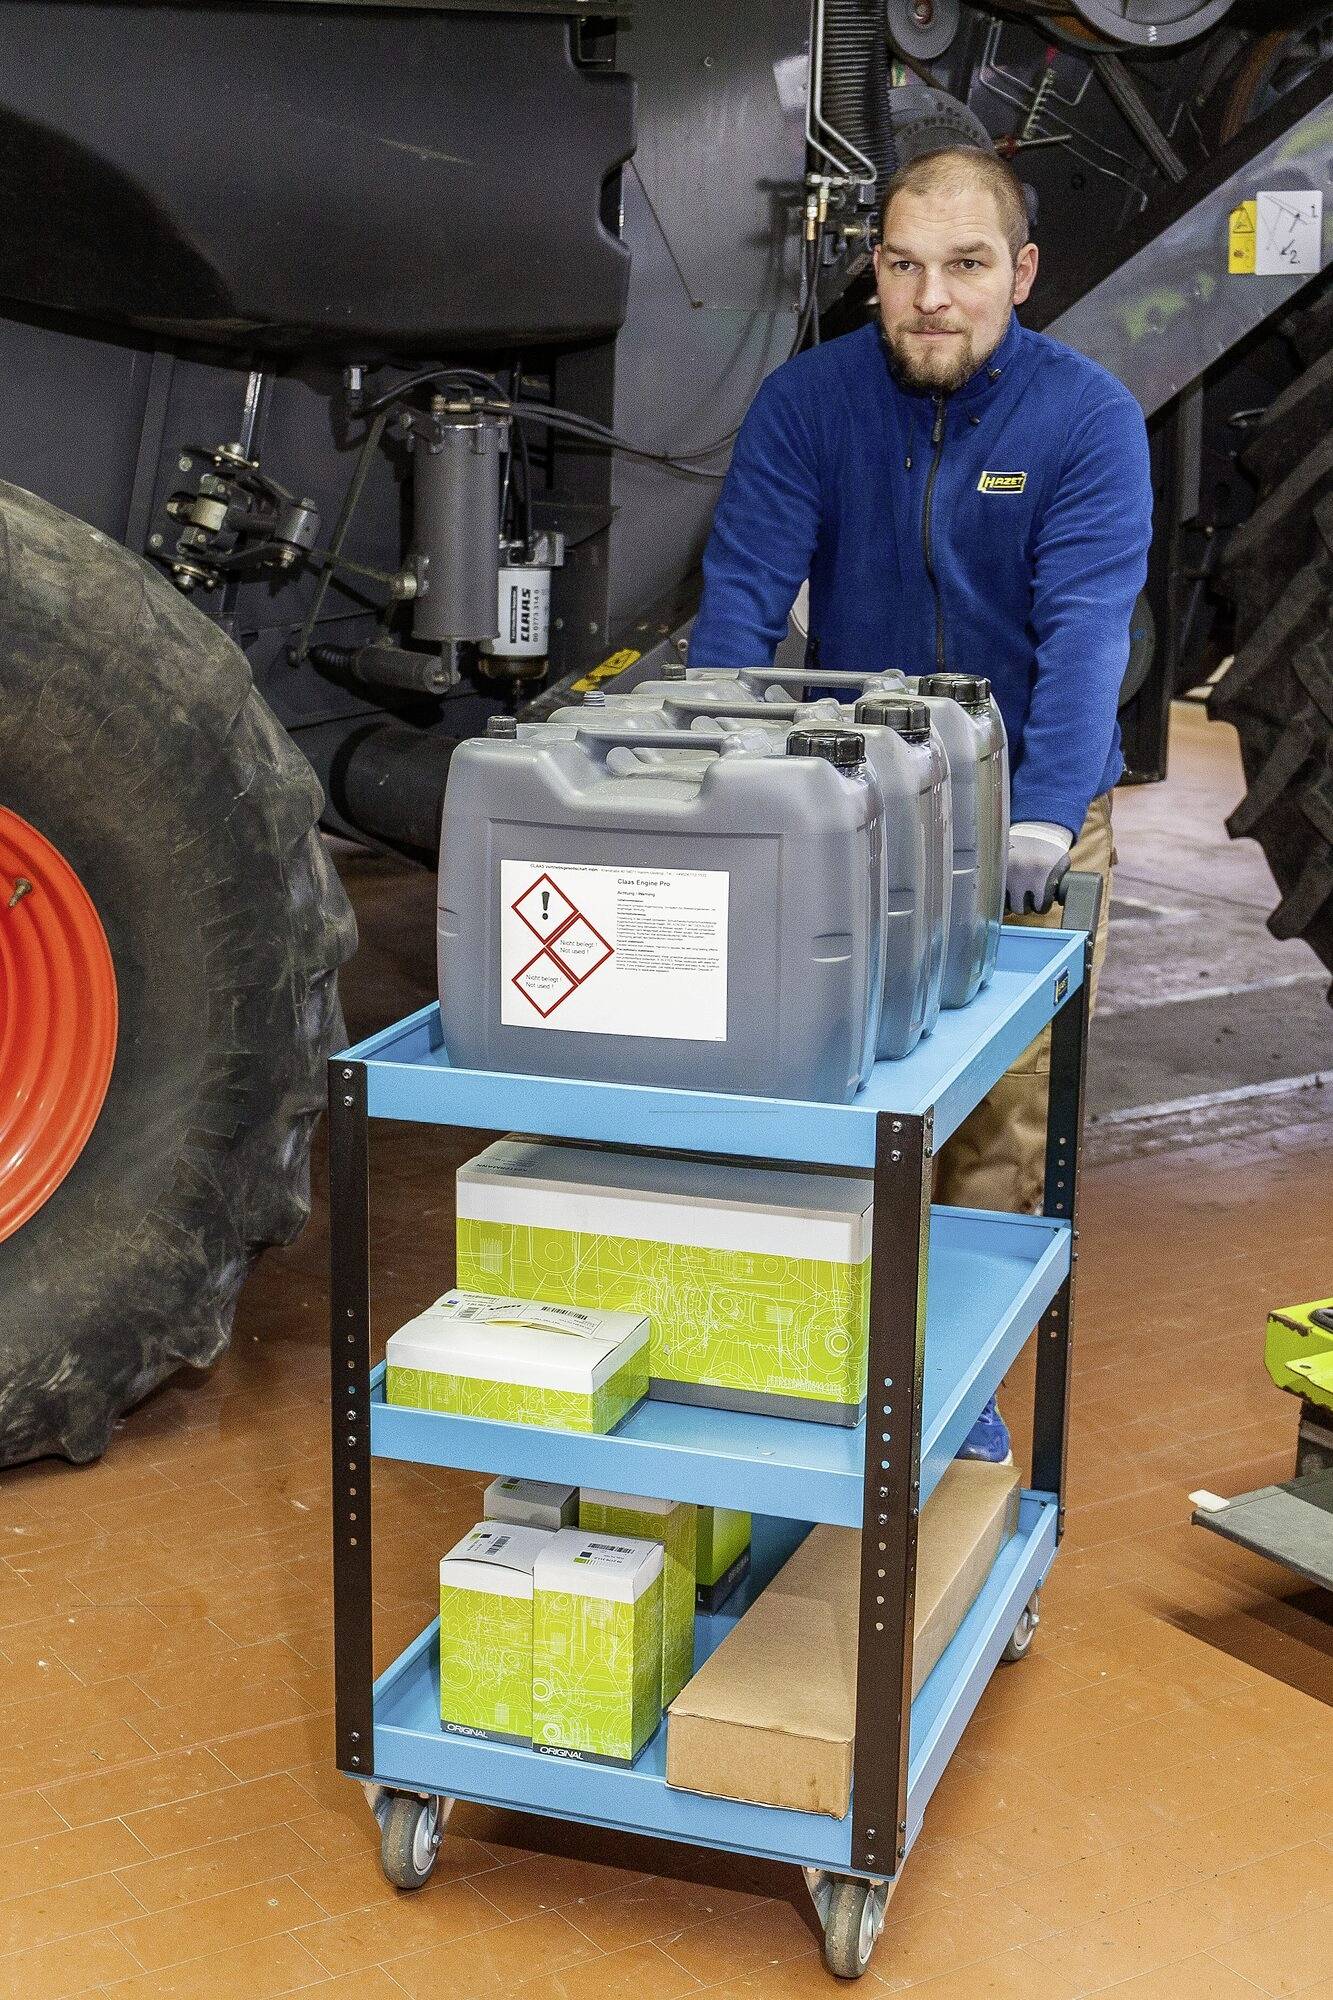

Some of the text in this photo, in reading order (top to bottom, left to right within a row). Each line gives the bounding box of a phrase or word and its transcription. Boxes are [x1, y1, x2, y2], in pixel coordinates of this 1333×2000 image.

[984, 476, 1024, 488] HAZET
[521, 588, 531, 642] CLAAS
[541, 975, 559, 983] belegt
[446, 1724, 488, 1738] ORIGINAL
[540, 1746, 583, 1760] ORIGINAL
